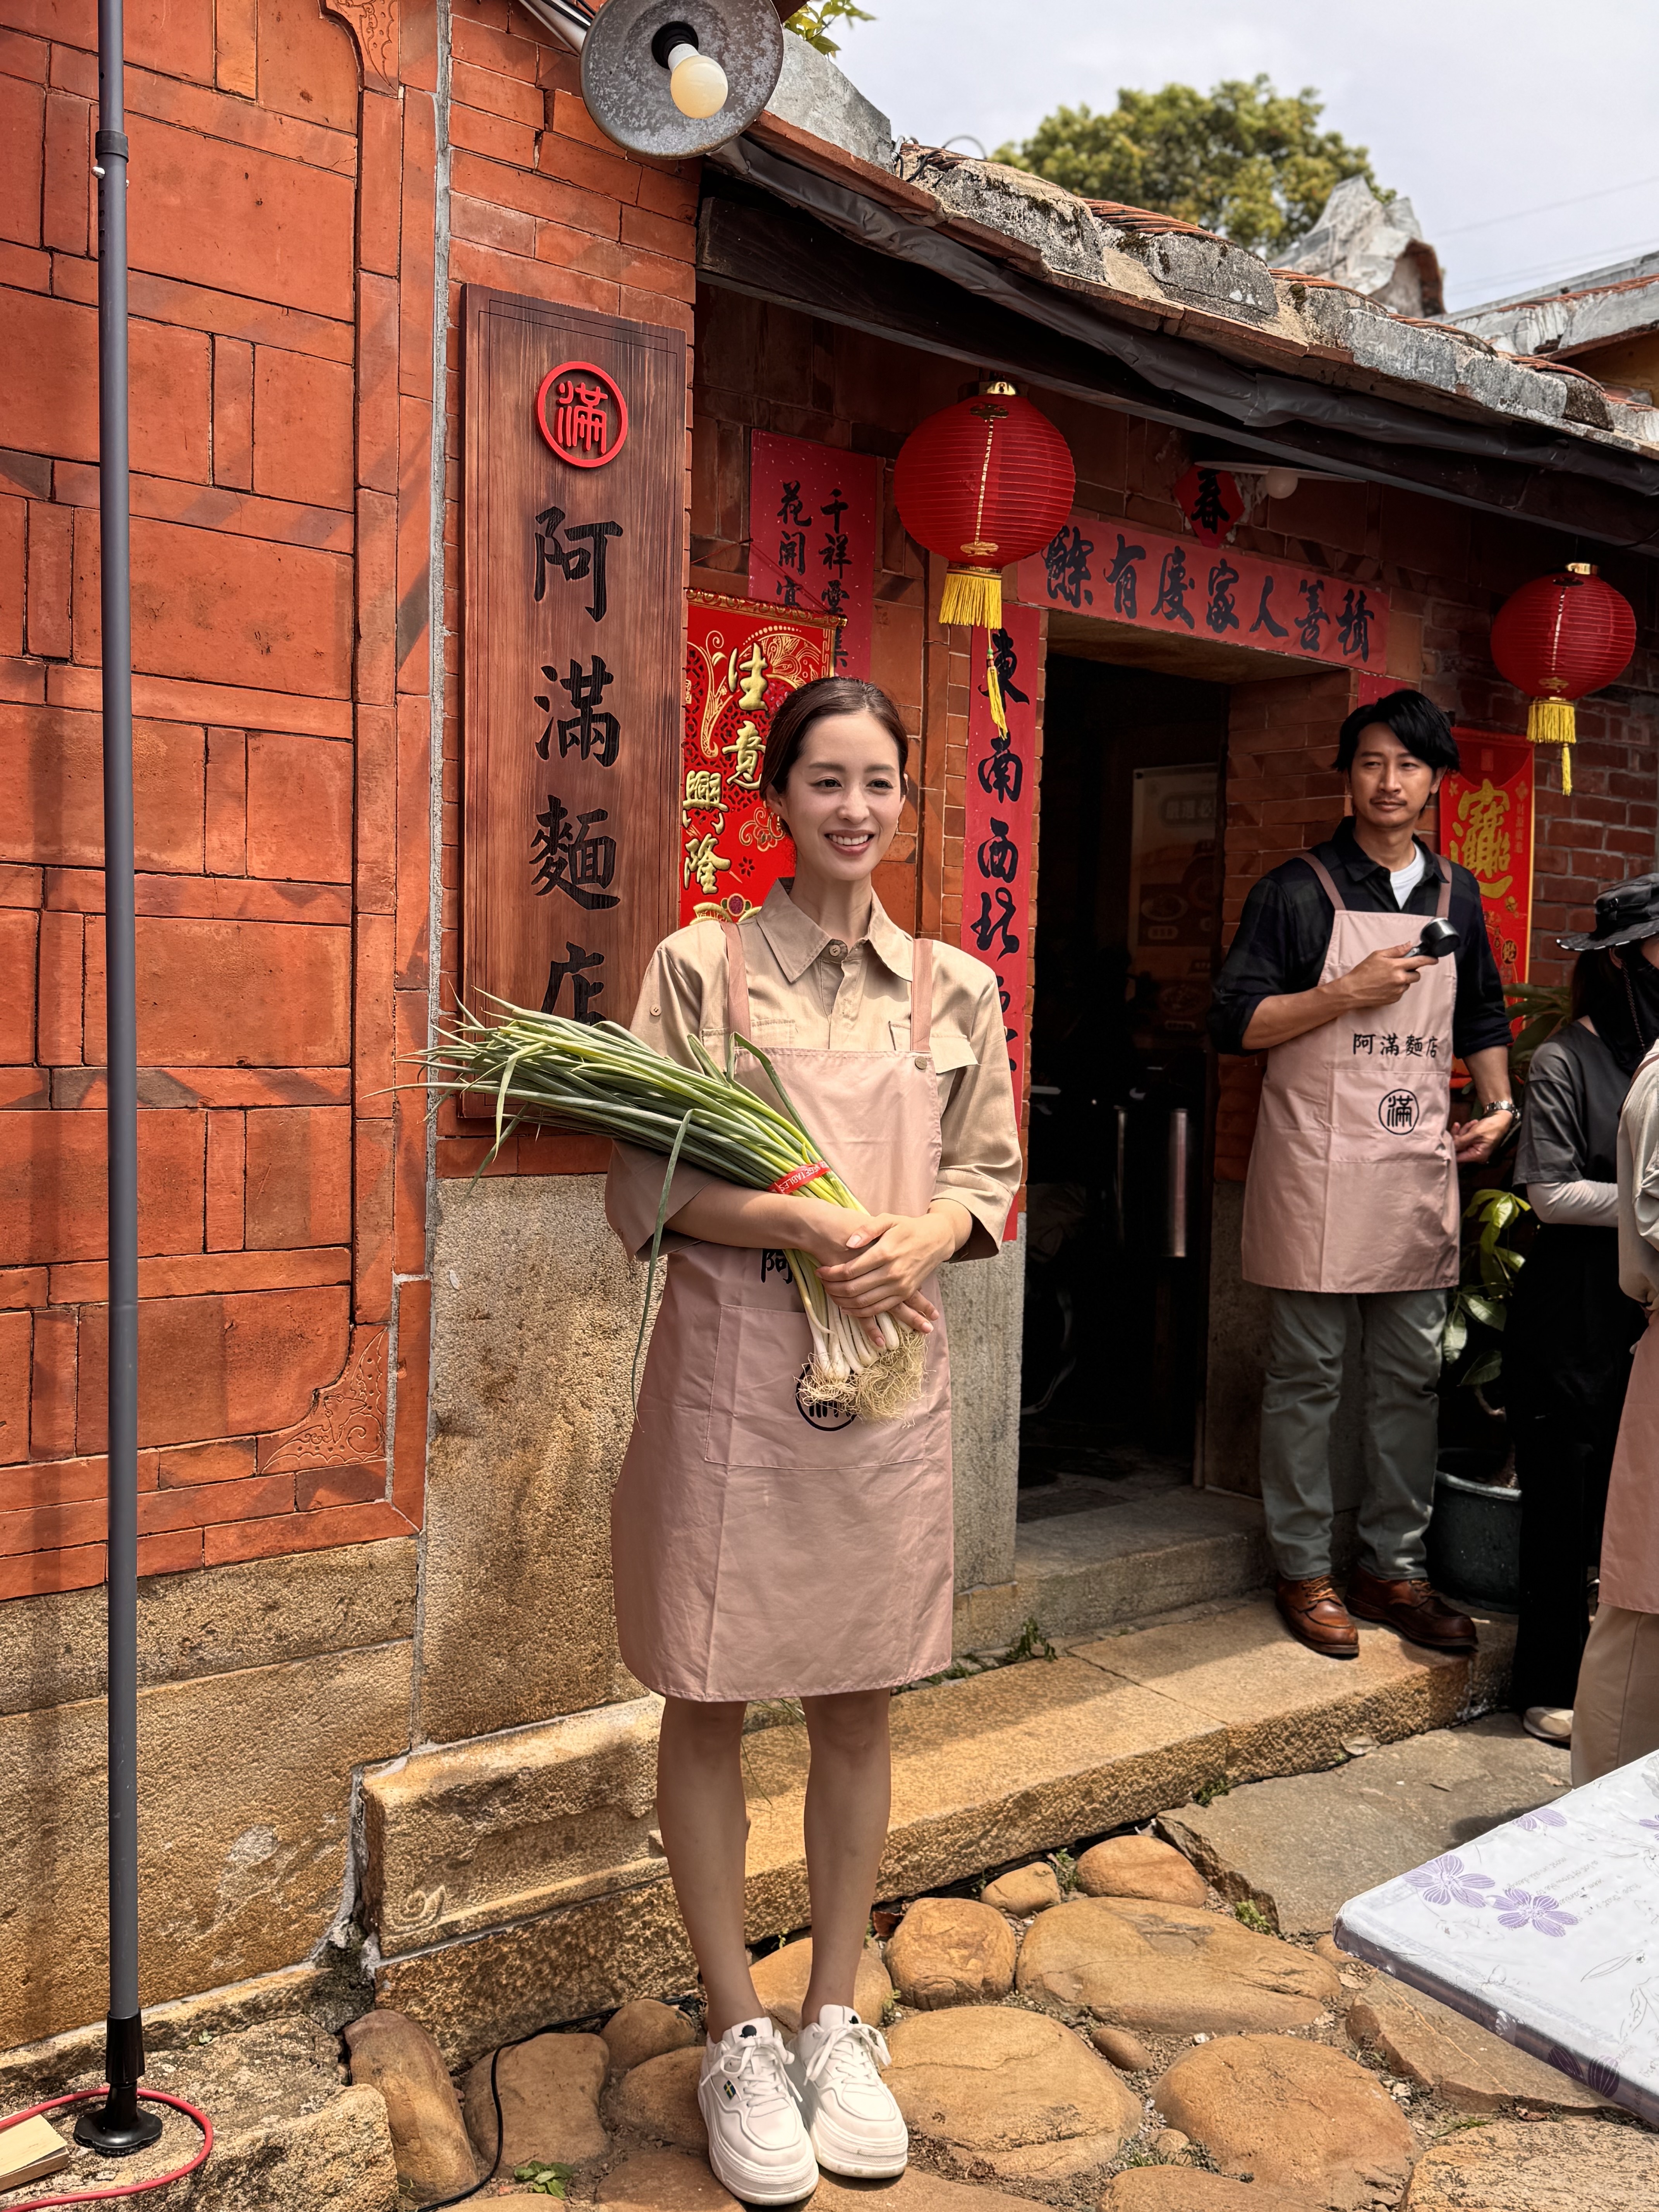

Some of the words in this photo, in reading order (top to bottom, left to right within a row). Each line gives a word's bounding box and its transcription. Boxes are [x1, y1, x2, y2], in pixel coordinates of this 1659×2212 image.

[529, 506, 623, 1026] 阿滿麵店
[1352, 1032, 1439, 1058] 阿滿麵店
[780, 1165, 821, 1193] VEGETABLES
